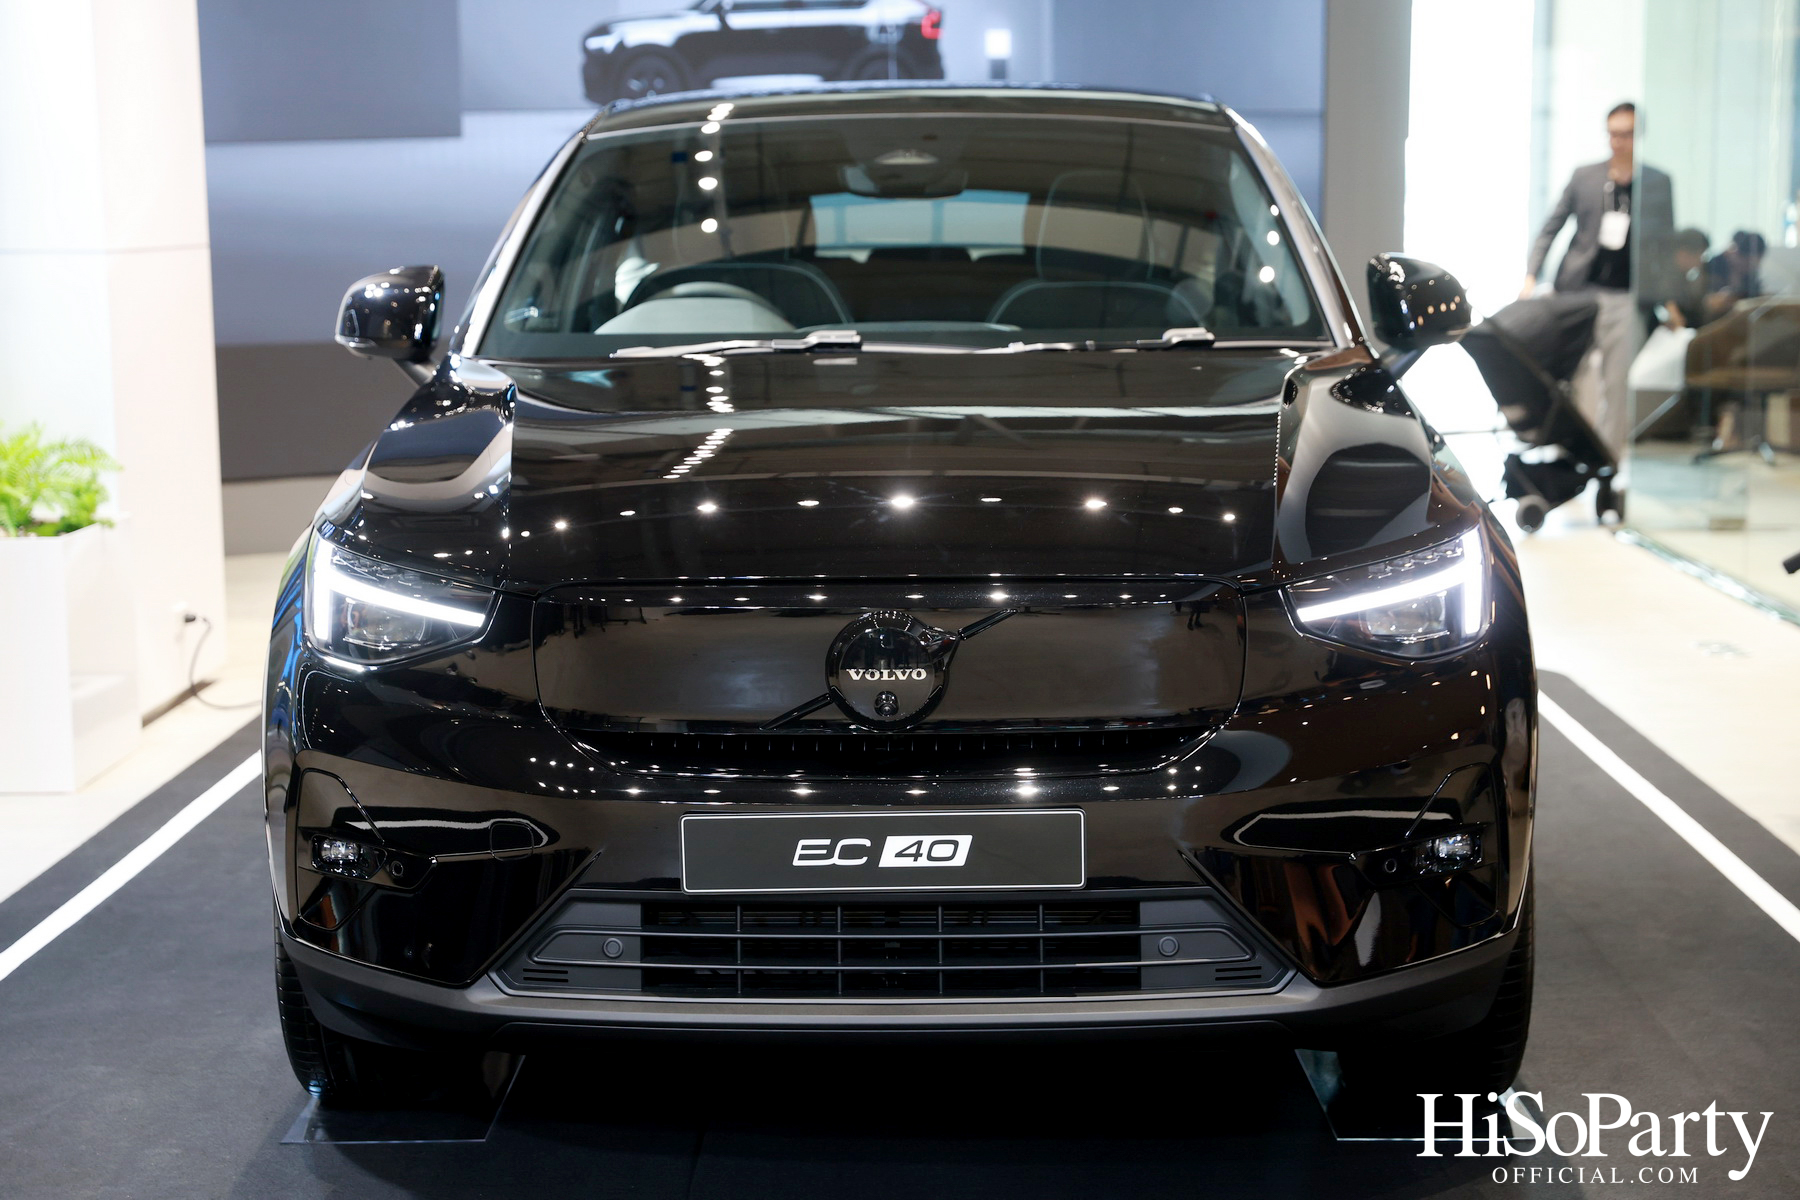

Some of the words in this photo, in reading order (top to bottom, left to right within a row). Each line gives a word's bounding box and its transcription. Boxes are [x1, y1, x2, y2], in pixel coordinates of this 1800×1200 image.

[846, 668, 927, 681] VOLVO
[792, 838, 872, 866] EC
[892, 838, 961, 864] 40
